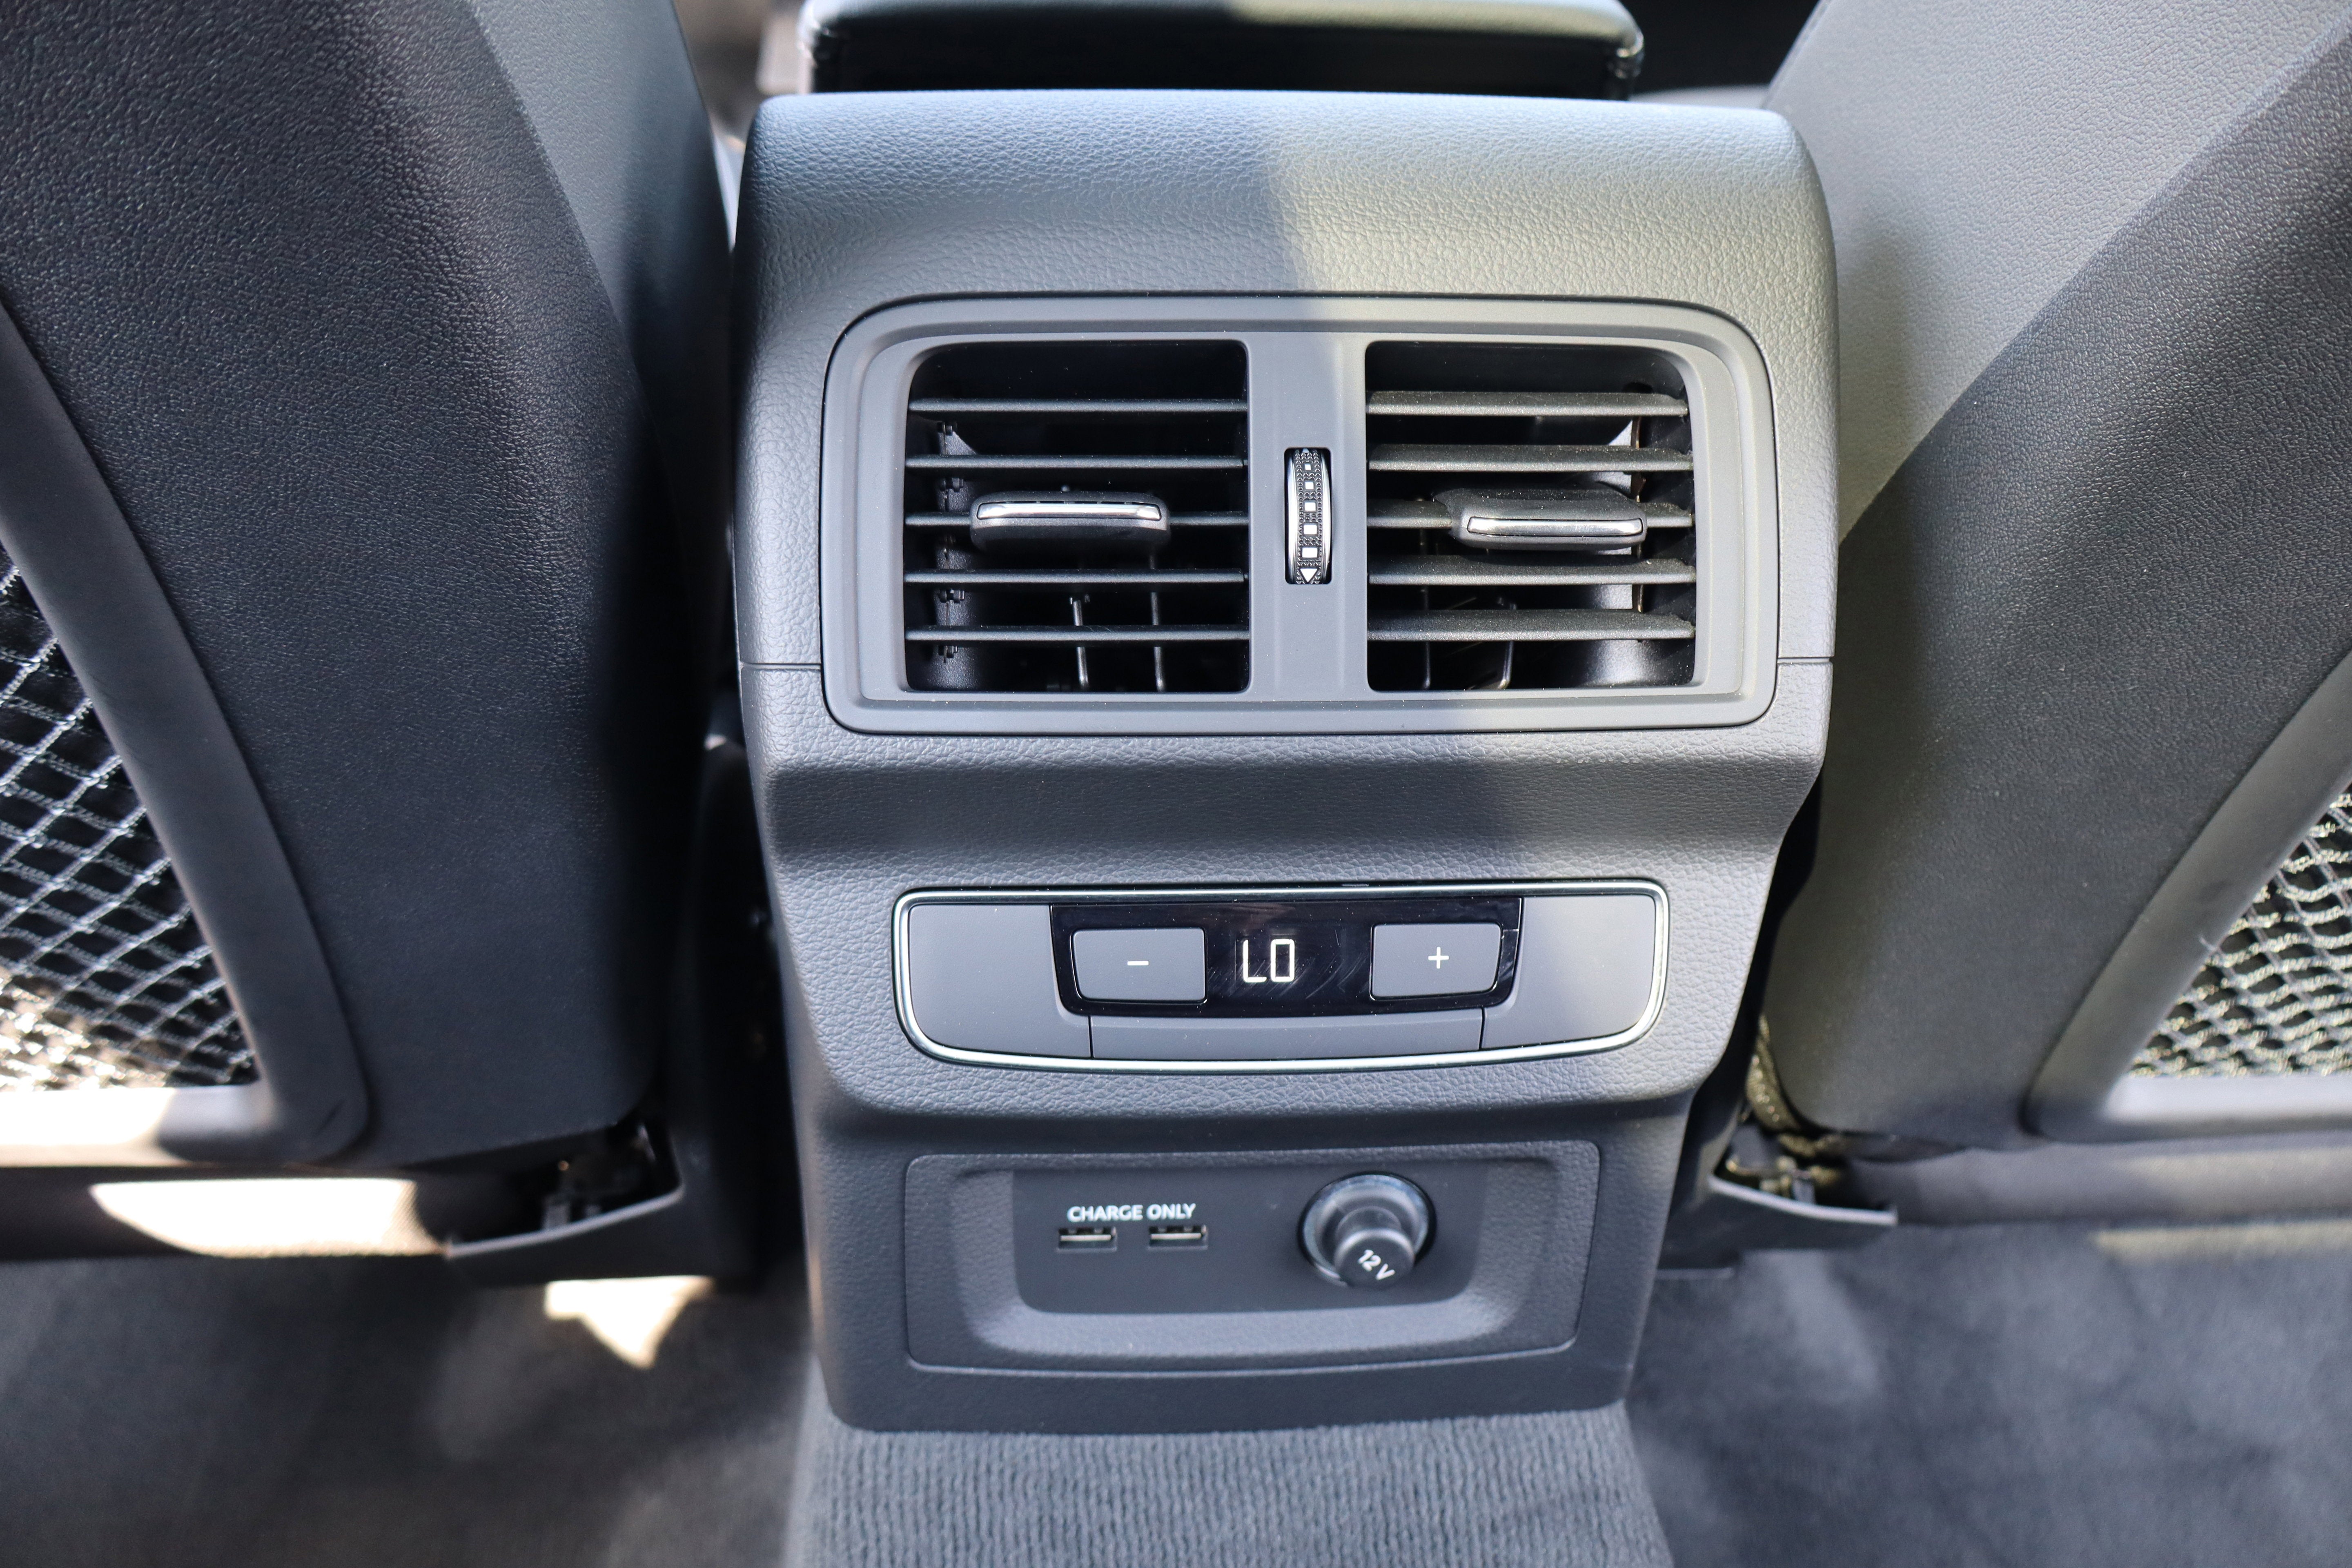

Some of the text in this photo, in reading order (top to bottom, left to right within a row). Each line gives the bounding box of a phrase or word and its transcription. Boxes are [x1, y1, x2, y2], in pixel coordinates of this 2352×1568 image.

[1243, 938, 1295, 983] LO
[1067, 1203, 1196, 1223] CHARGE ONLY
